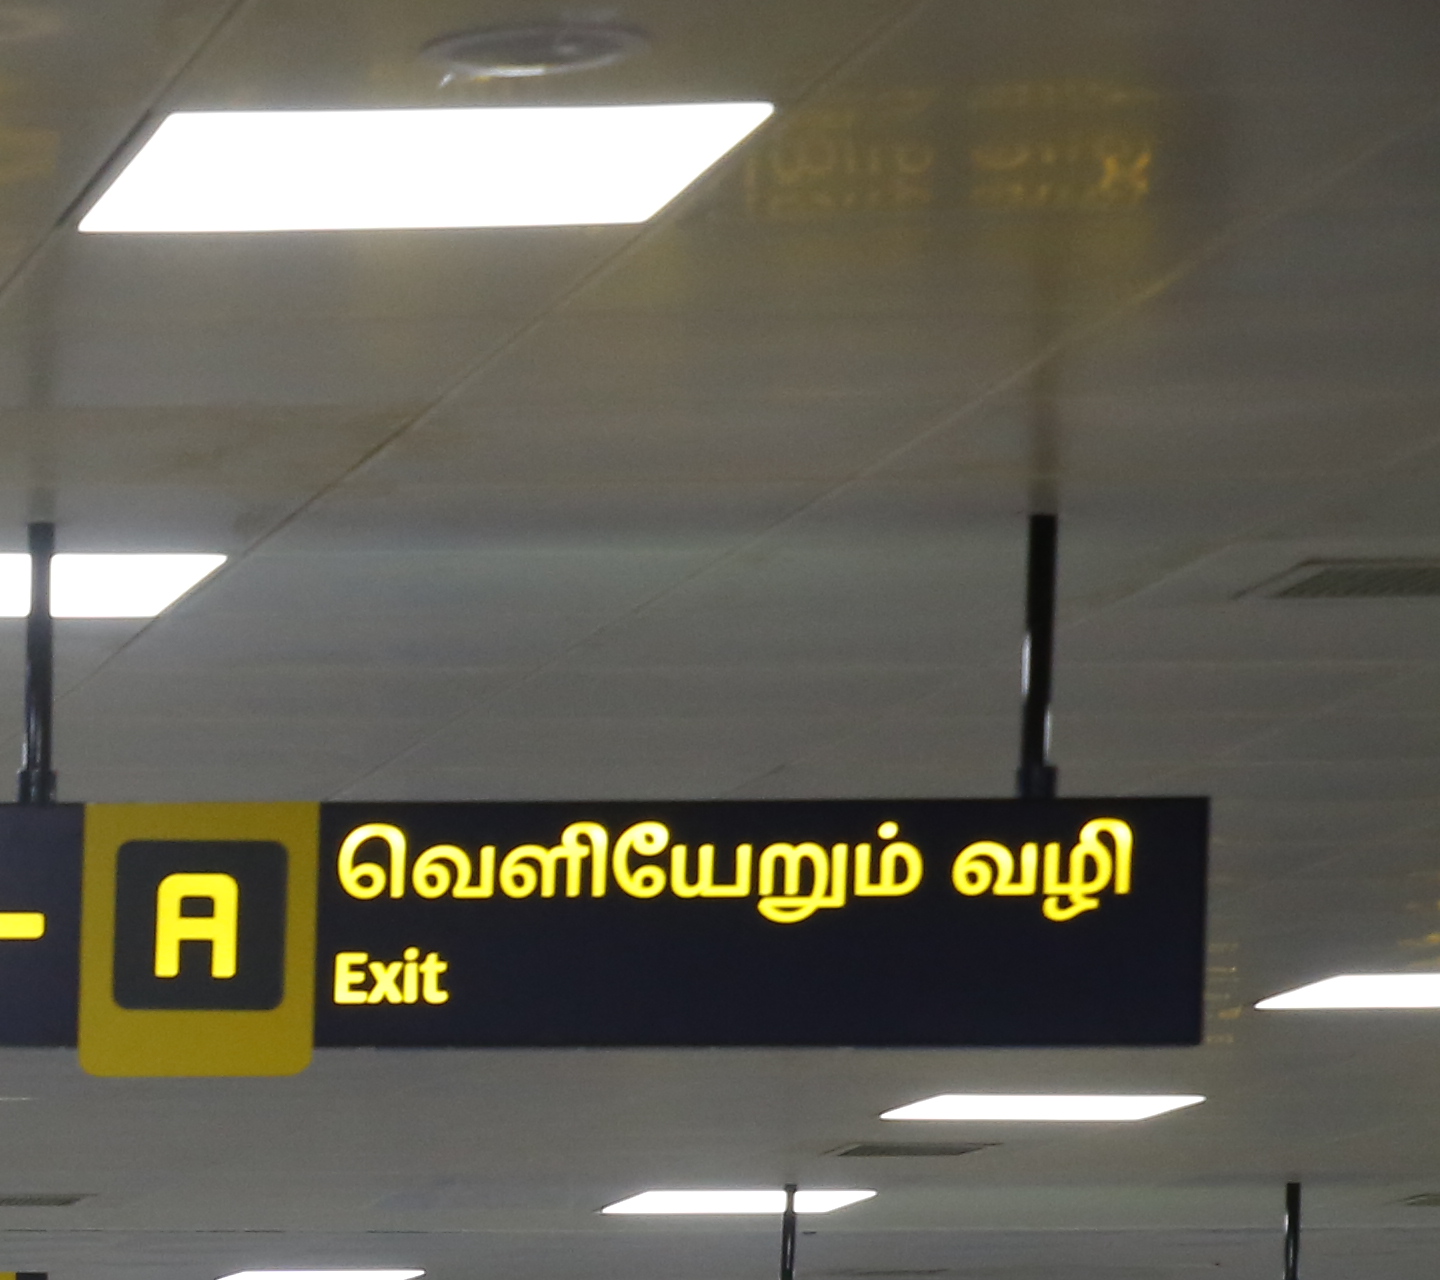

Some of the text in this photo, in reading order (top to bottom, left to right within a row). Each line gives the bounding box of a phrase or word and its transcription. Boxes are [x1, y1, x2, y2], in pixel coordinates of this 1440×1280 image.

[336, 817, 1134, 924] வெளியேறும் வழி
[154, 874, 239, 980] A
[331, 949, 449, 1004] Exit
